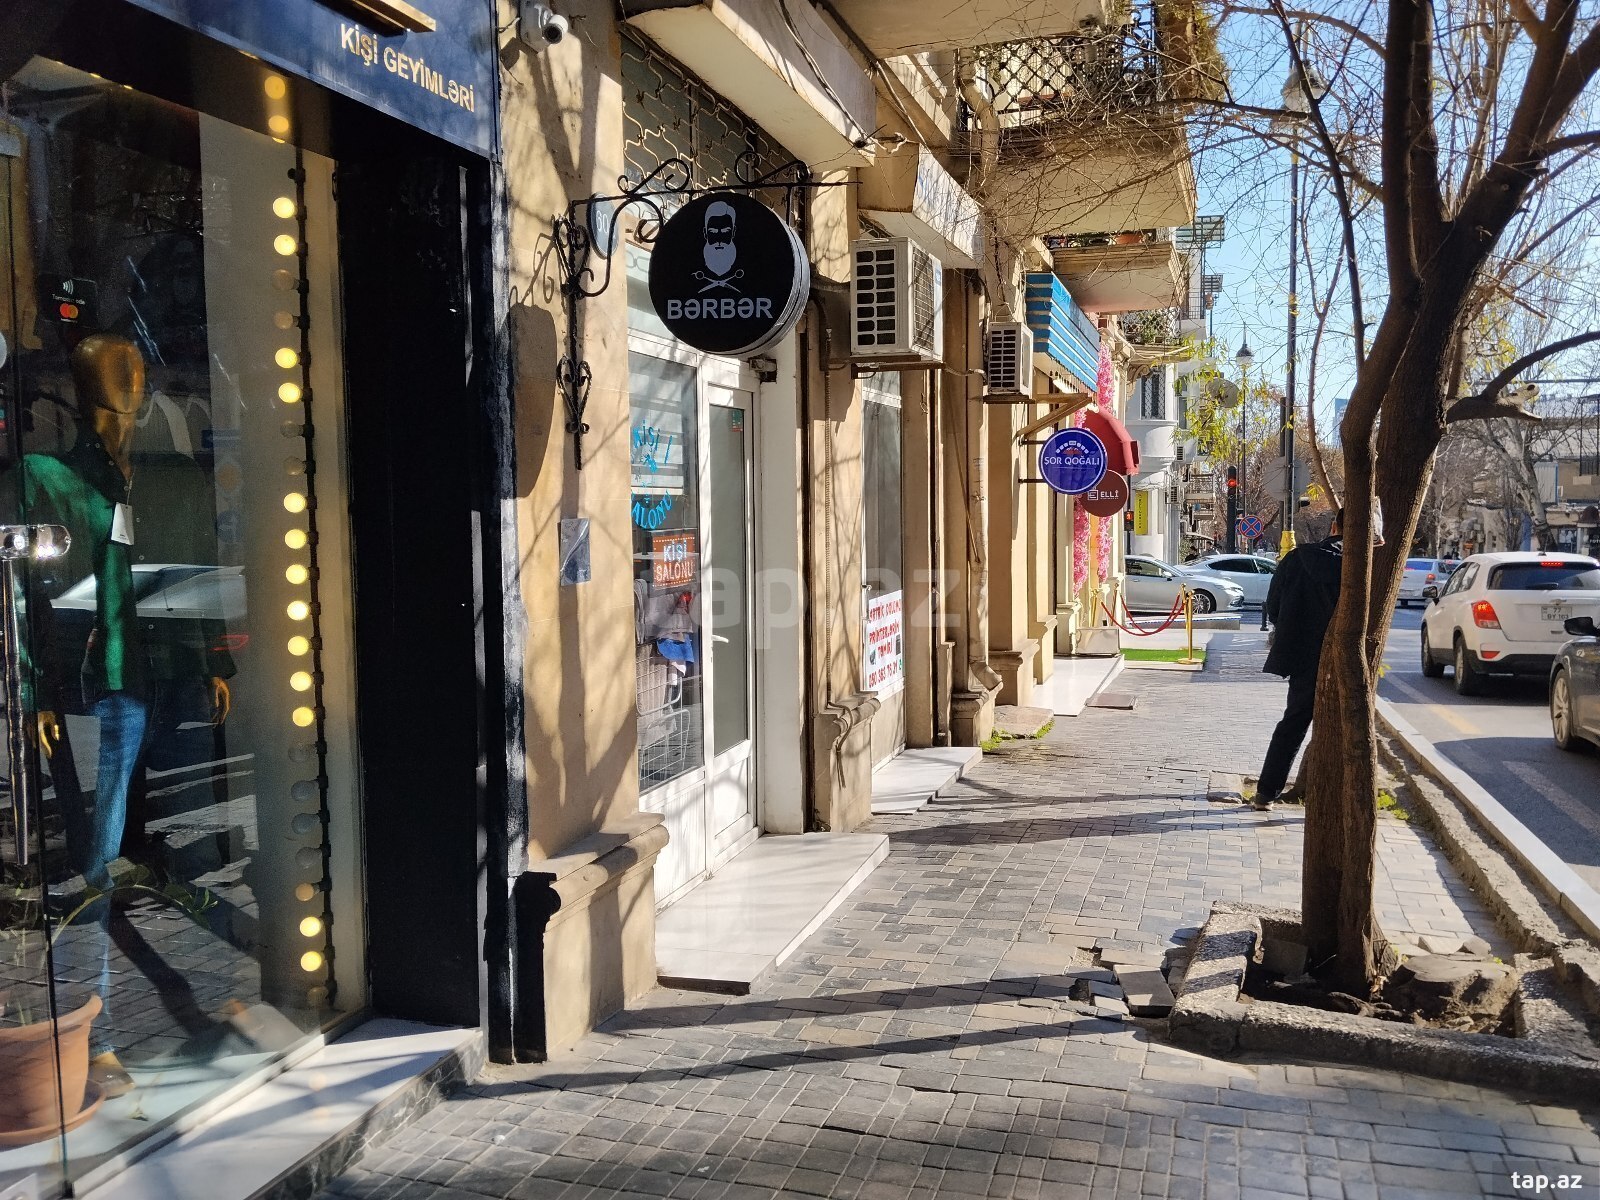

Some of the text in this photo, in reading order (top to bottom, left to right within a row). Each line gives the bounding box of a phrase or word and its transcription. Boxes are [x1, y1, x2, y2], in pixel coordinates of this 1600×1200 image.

[341, 23, 475, 112] KİŞİ GEYİMLƏRİ
[667, 297, 773, 320] BƏRBƏR
